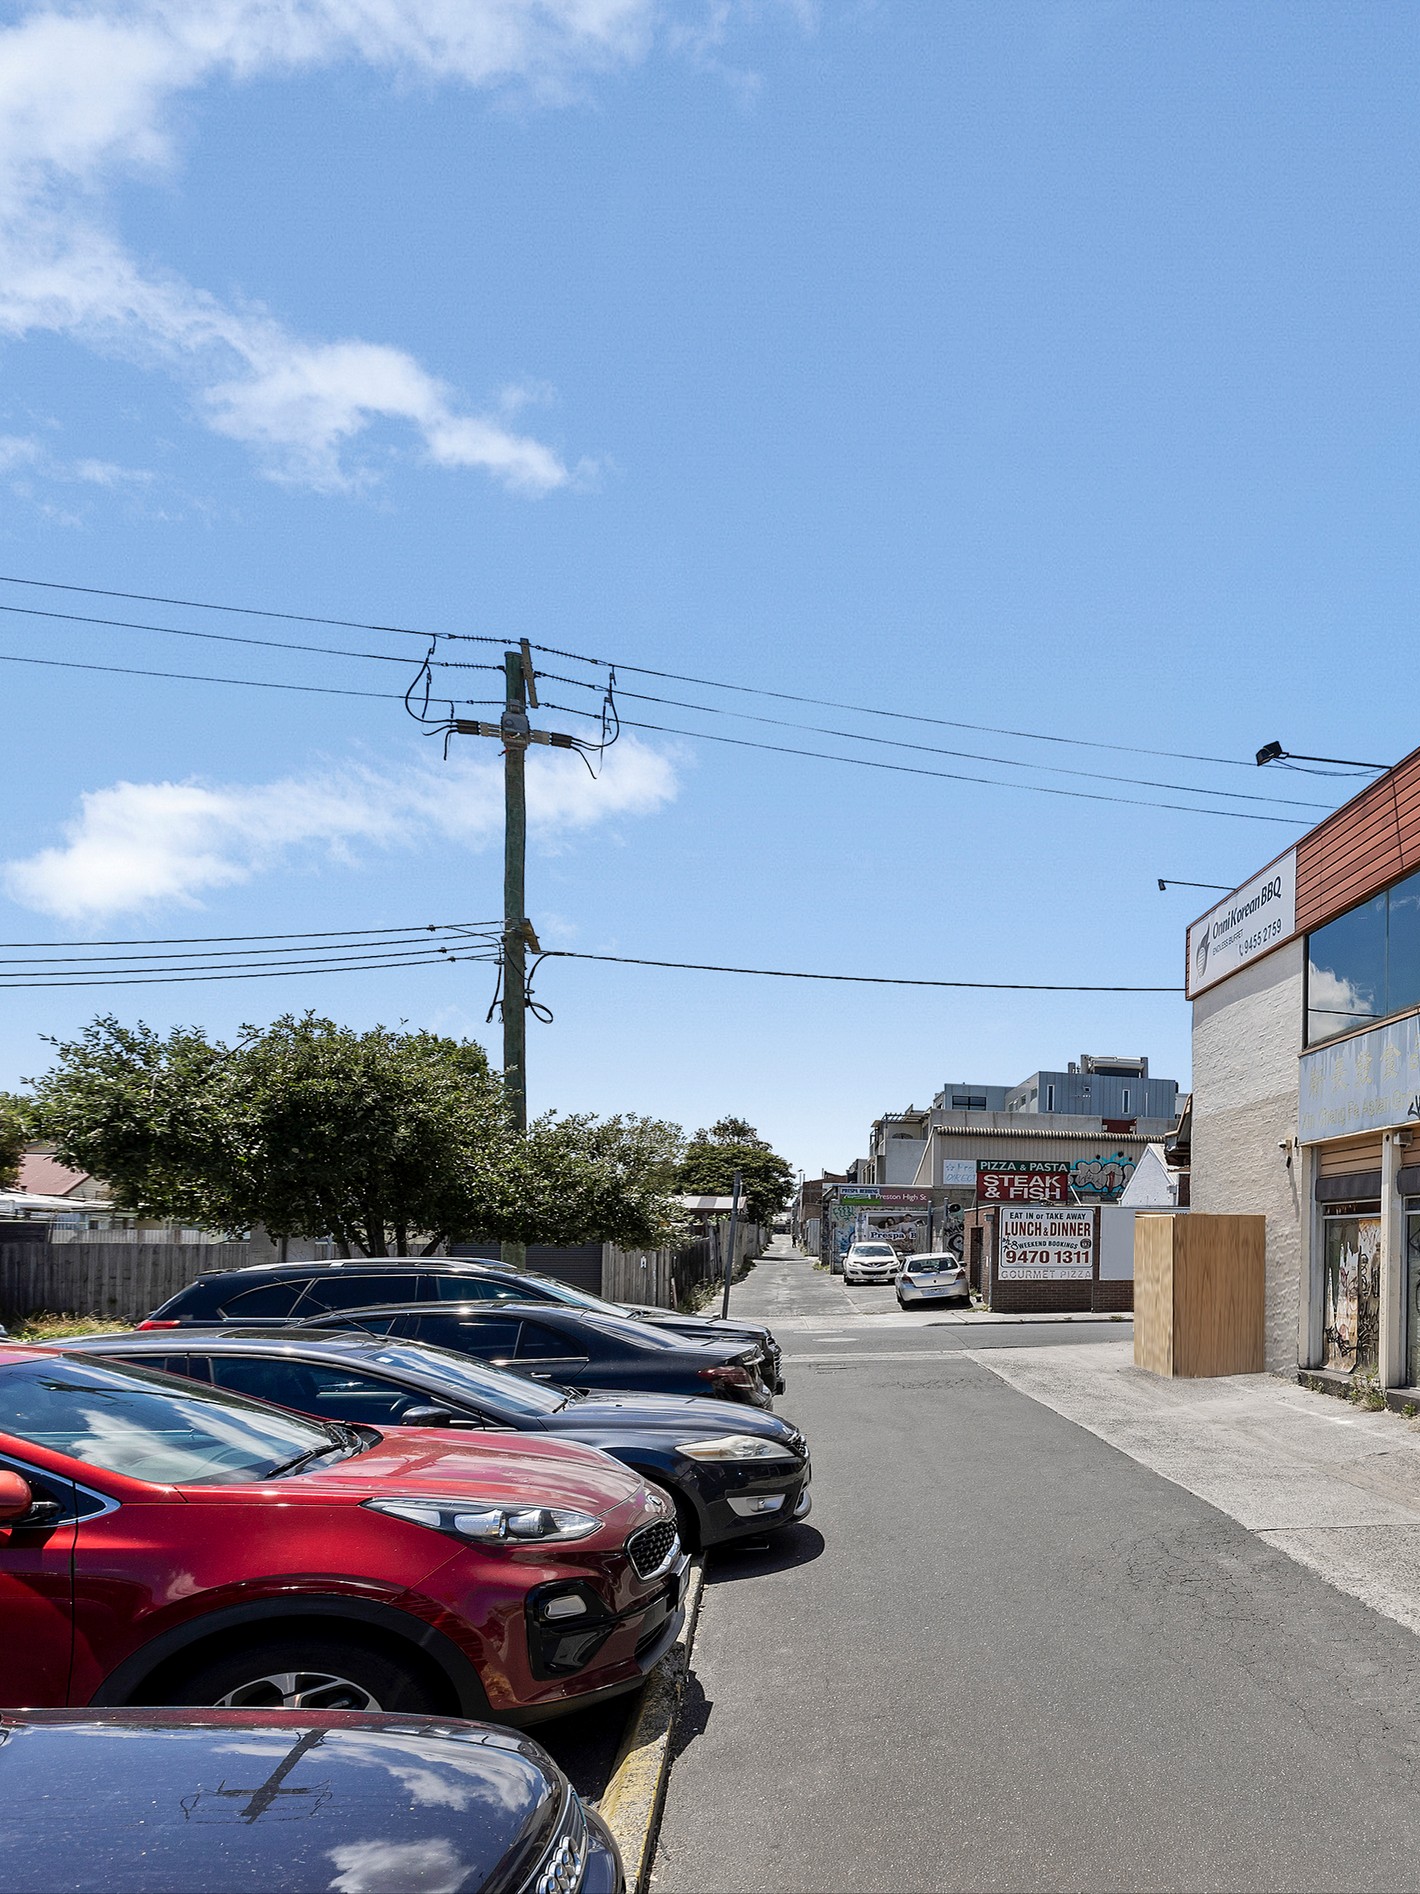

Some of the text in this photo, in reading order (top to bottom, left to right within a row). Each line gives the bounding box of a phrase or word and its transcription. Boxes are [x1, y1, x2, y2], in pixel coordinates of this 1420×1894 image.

[1213, 876, 1281, 939] Onni Korean BBQ
[1245, 919, 1281, 954] 9455 2759
[980, 1161, 1016, 1171] PIZZA
[1030, 1162, 1068, 1172] PASTA
[983, 1174, 1061, 1188] STEAK
[903, 1193, 918, 1202] High
[984, 1186, 1060, 1200] & FISH
[1046, 1212, 1063, 1220] TAKE
[1005, 1222, 1091, 1237] LUNCH & DINNER
[870, 1232, 904, 1240] Prespa
[1018, 1241, 1046, 1250] WEEKEND
[1048, 1241, 1078, 1250] BOOKINGS
[1006, 1250, 1089, 1264] 9470 1311
[1001, 1270, 1091, 1279] GOURMET PIZZA
